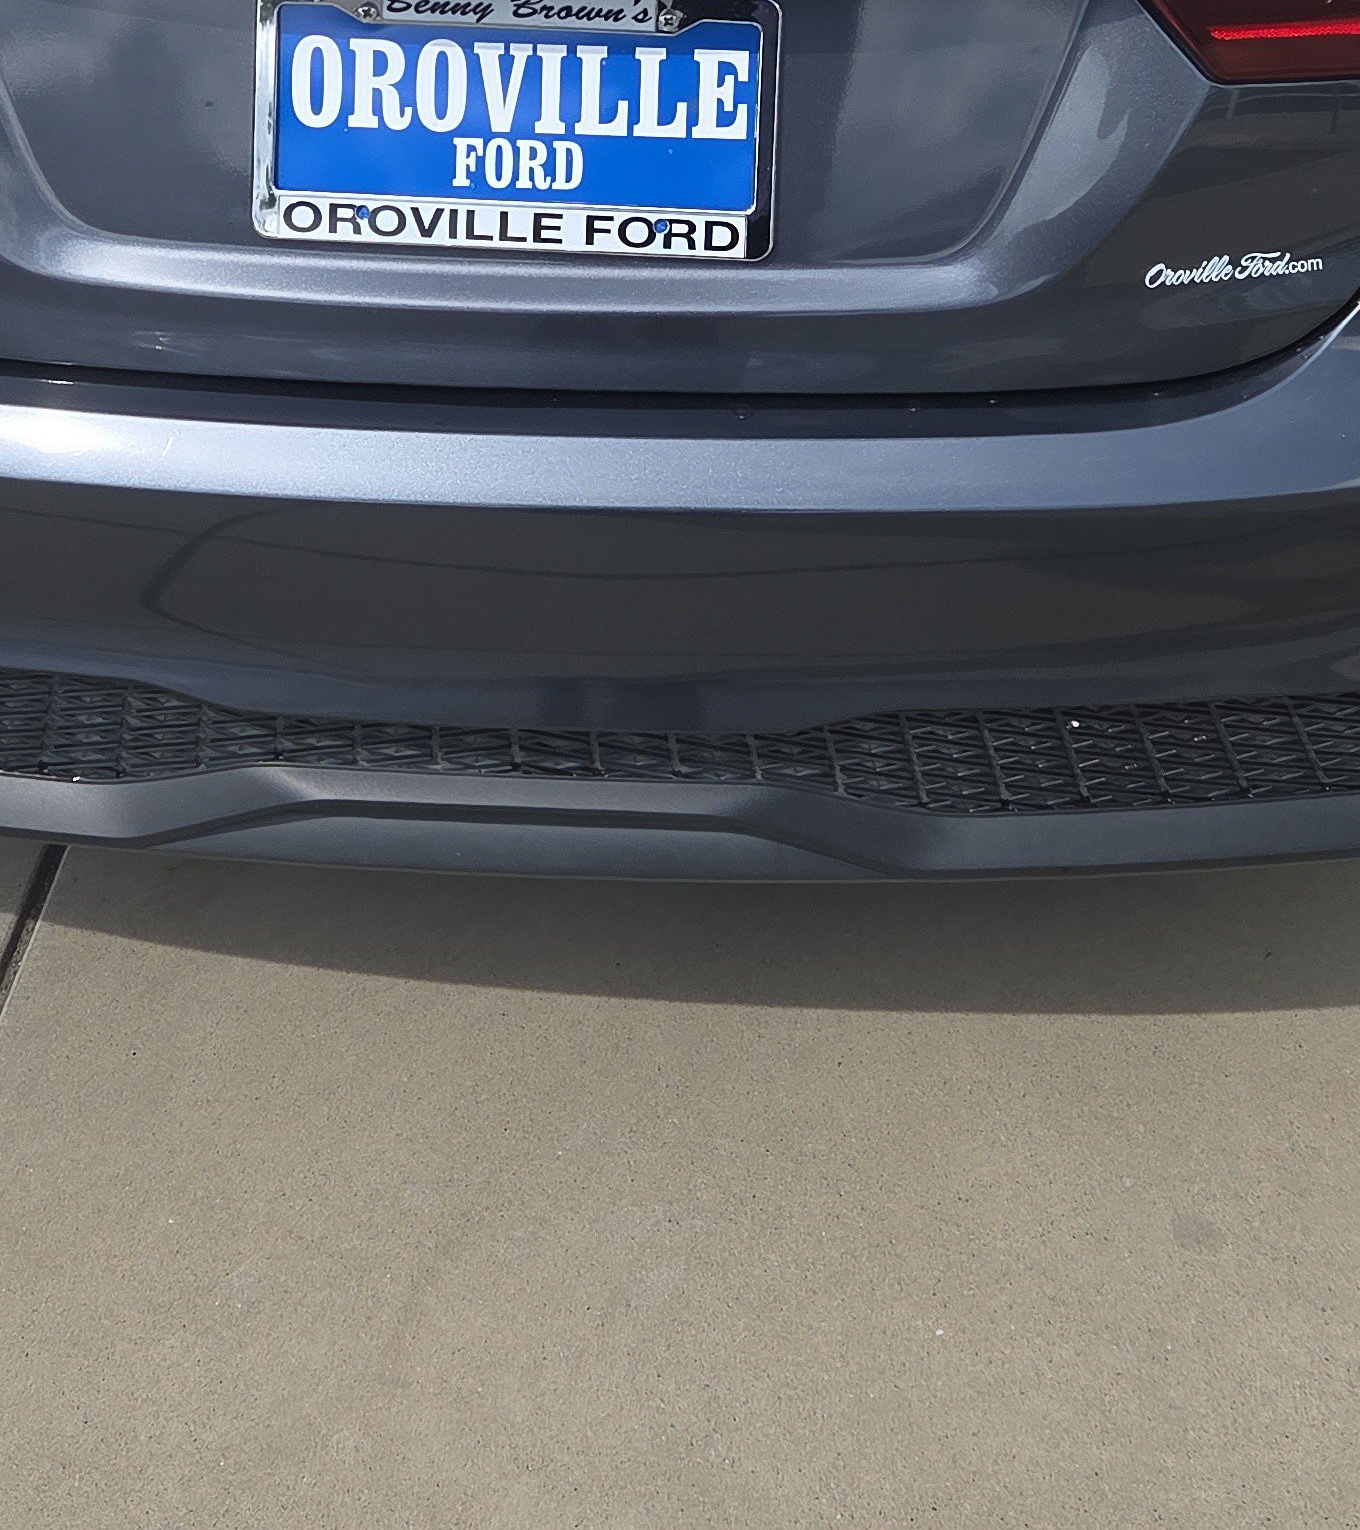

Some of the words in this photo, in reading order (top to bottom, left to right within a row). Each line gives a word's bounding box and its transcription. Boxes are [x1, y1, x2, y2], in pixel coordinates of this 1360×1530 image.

[291, 34, 751, 140] OROVILLE
[452, 137, 584, 190] FORD
[283, 201, 565, 245] OROVILLE
[585, 215, 740, 252] FORD
